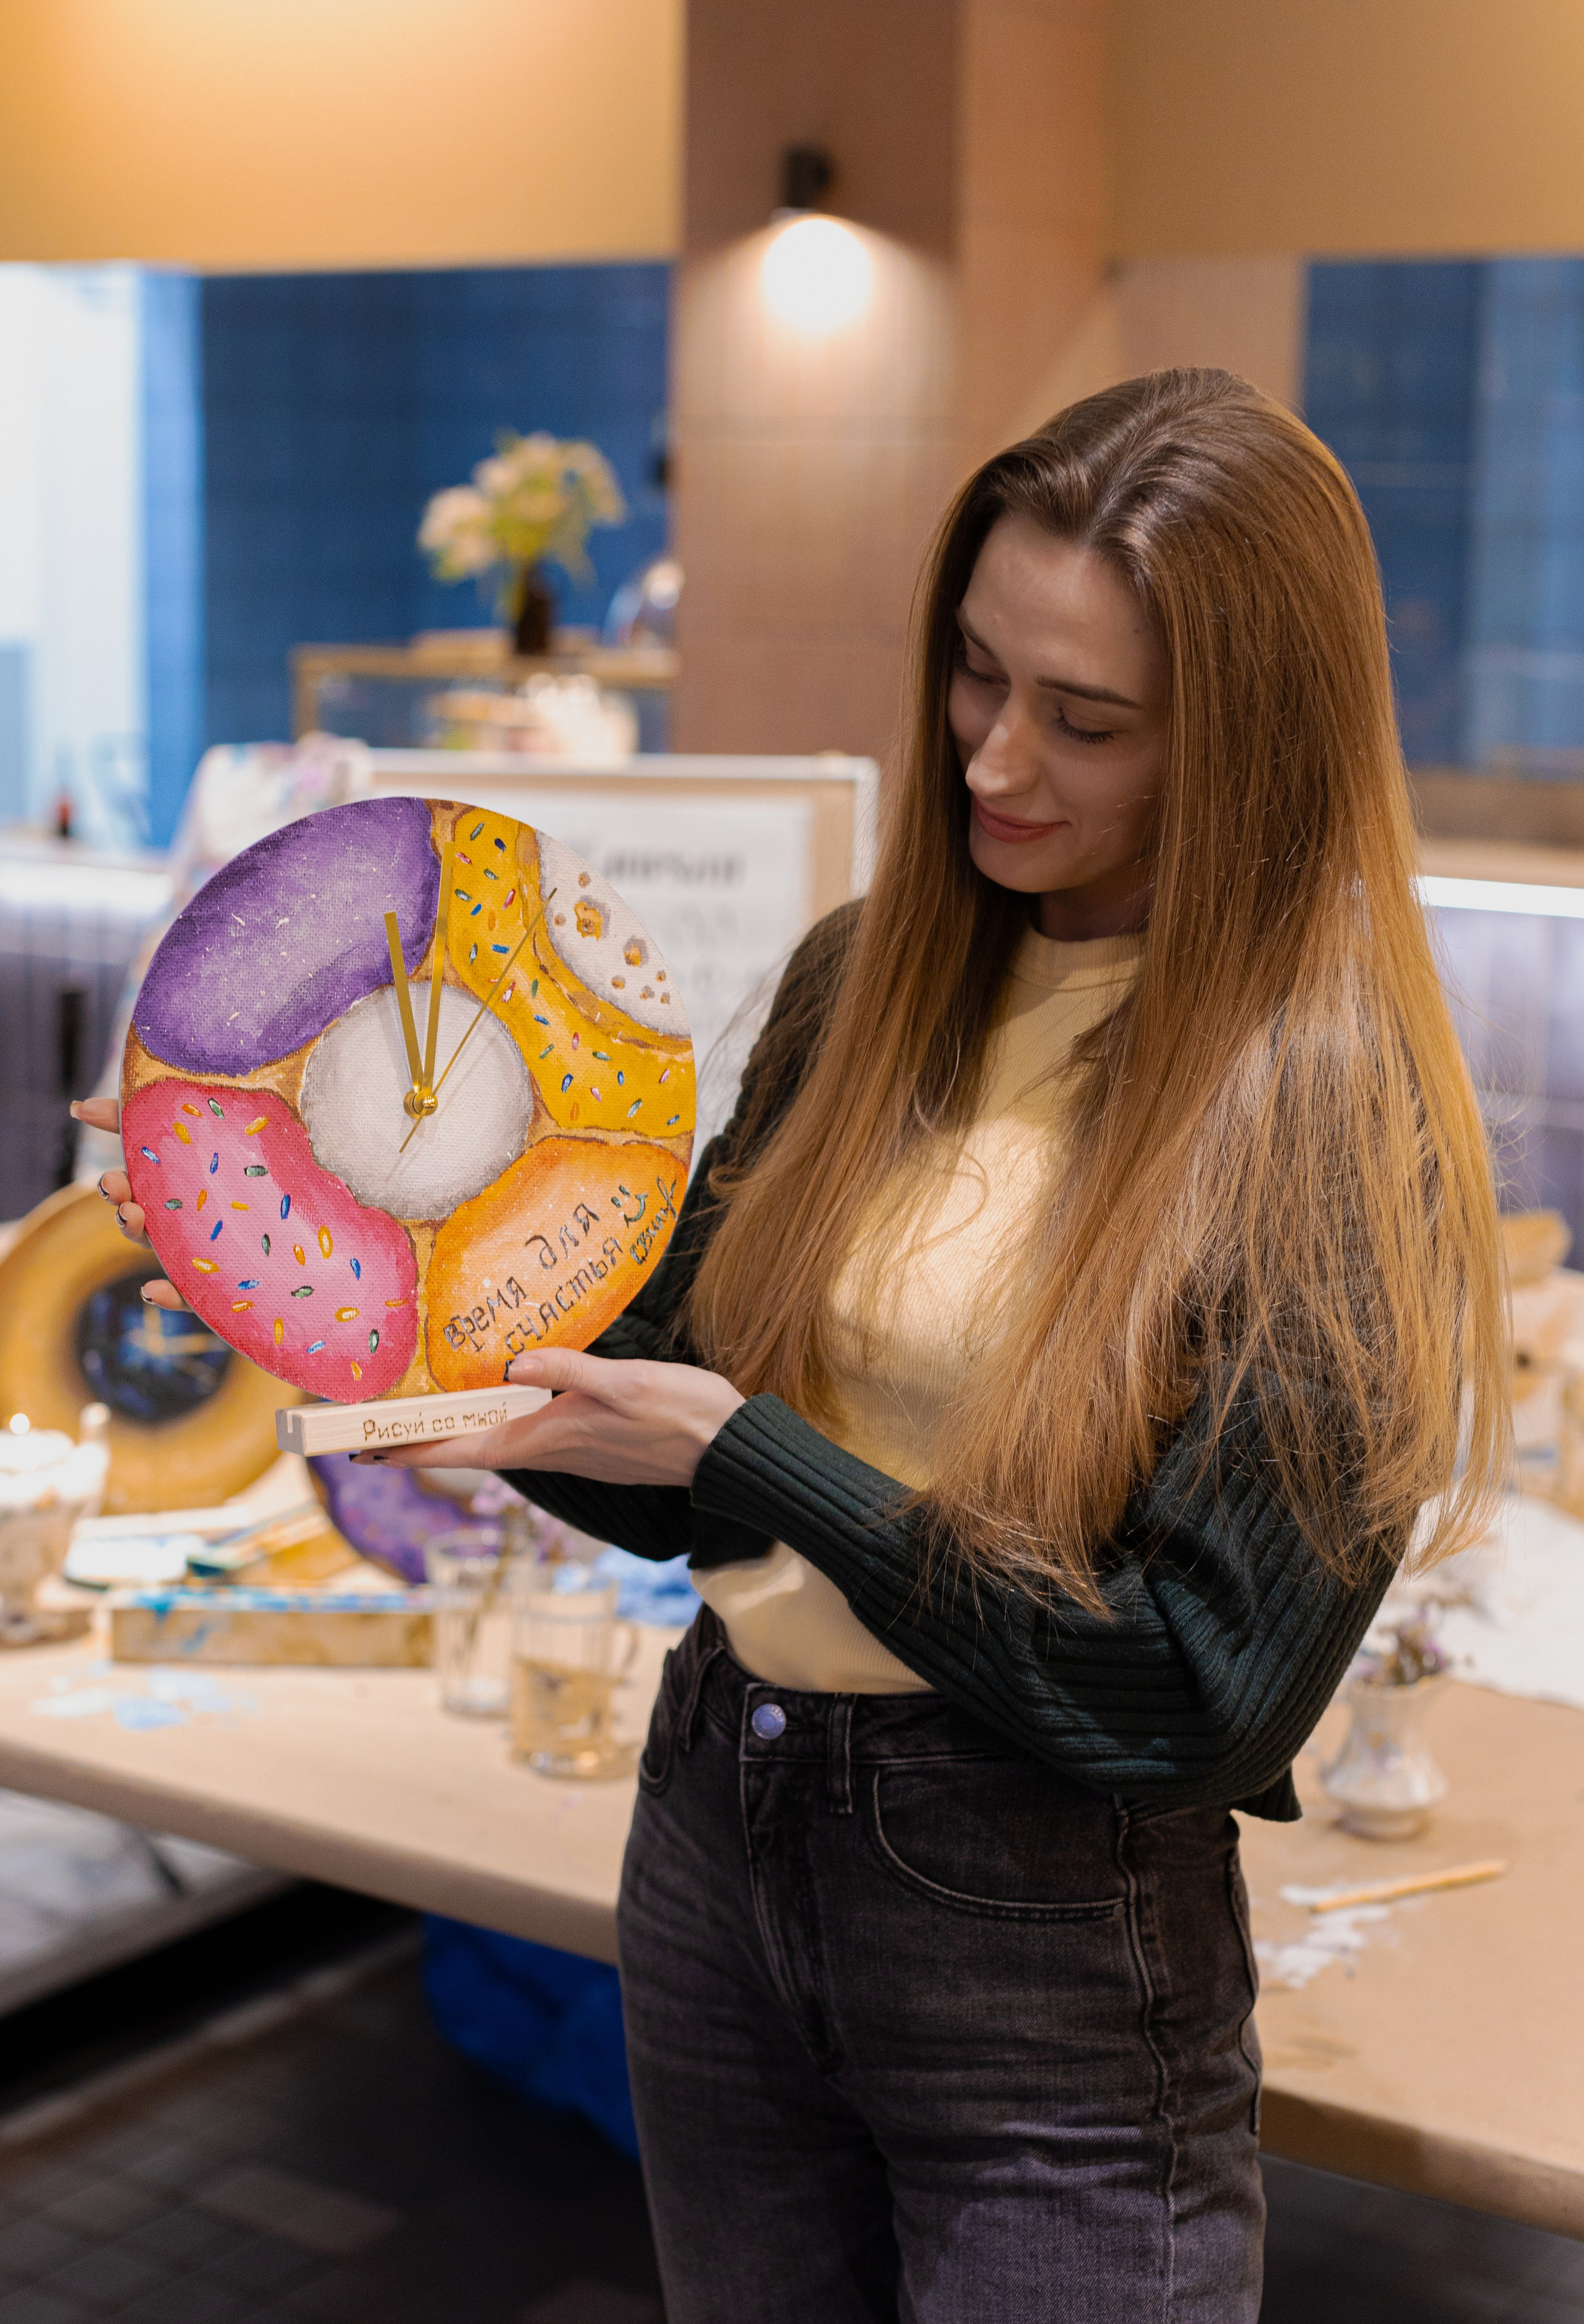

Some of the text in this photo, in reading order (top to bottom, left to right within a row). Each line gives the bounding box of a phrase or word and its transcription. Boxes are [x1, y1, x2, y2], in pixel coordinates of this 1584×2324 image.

[525, 1203, 600, 1271] для
[504, 1237, 624, 1355] счастья
[363, 1401, 509, 1442] Рисуй со мной
